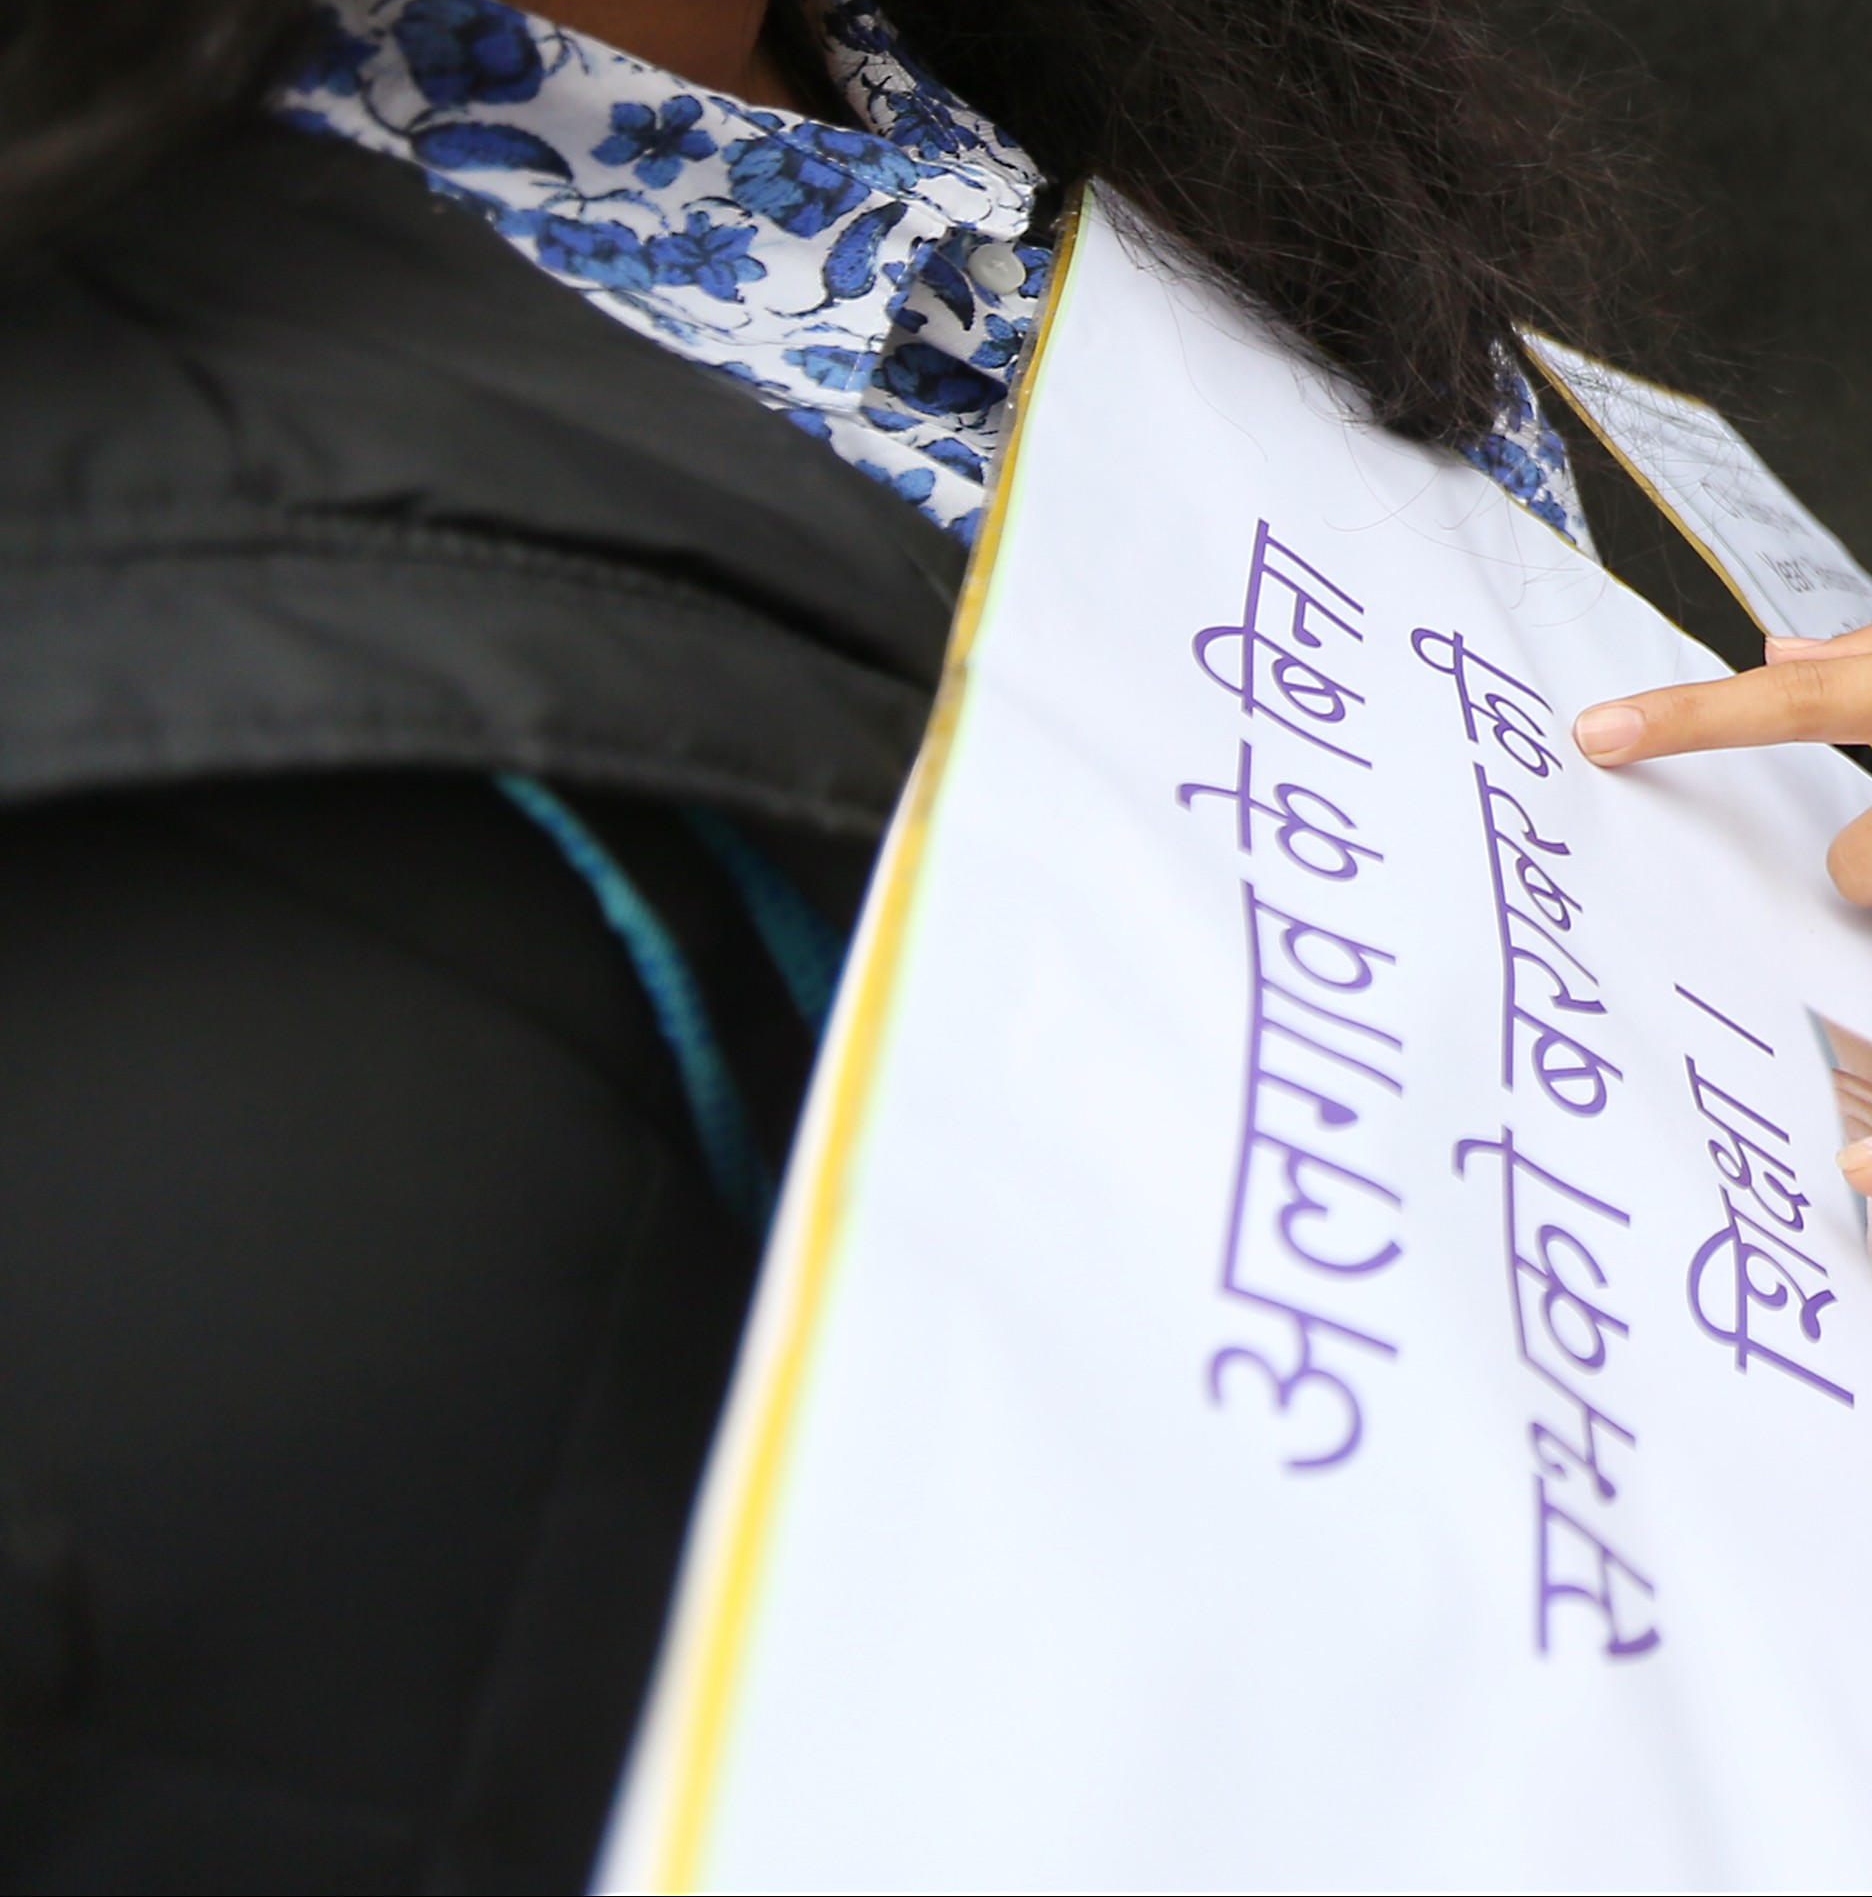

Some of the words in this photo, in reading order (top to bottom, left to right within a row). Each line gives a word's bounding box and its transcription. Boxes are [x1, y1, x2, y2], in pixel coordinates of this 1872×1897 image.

[1191, 518, 1374, 769] बिना
[1409, 627, 1560, 781] की
[1176, 740, 1385, 882] के
[1472, 761, 1624, 1119] बराबर
[1206, 881, 1405, 1475] अलगाव
[1684, 1053, 1856, 1407] शिक्षा
